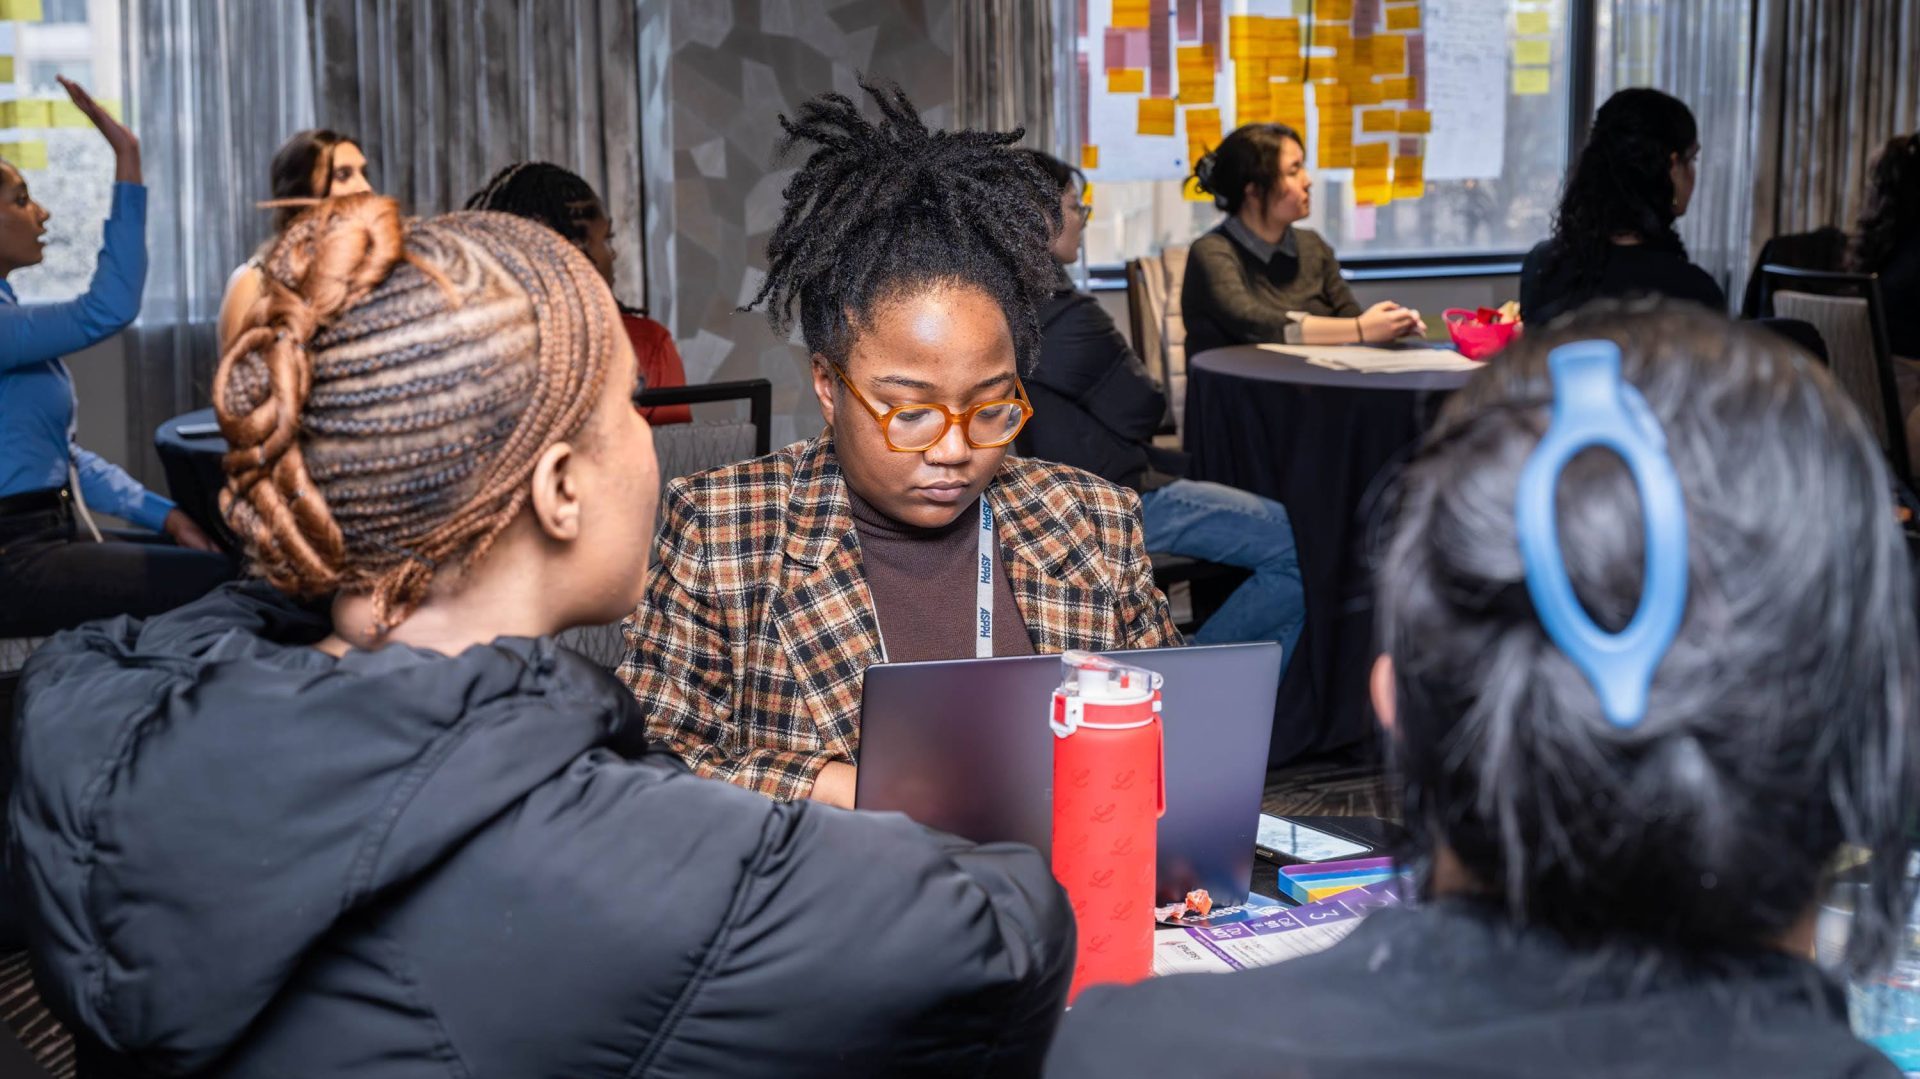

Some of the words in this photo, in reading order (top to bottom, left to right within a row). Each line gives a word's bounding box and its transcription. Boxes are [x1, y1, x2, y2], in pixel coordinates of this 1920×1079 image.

[982, 500, 993, 531] ASPPH
[980, 553, 991, 584] ASPPH
[979, 607, 991, 638] ASPPH
[1111, 769, 1135, 790] L
[1089, 803, 1116, 823] L
[1110, 836, 1134, 856] L
[1088, 869, 1114, 889] L
[1110, 900, 1134, 921] L
[1309, 909, 1340, 920] 3
[1086, 934, 1112, 954] L
